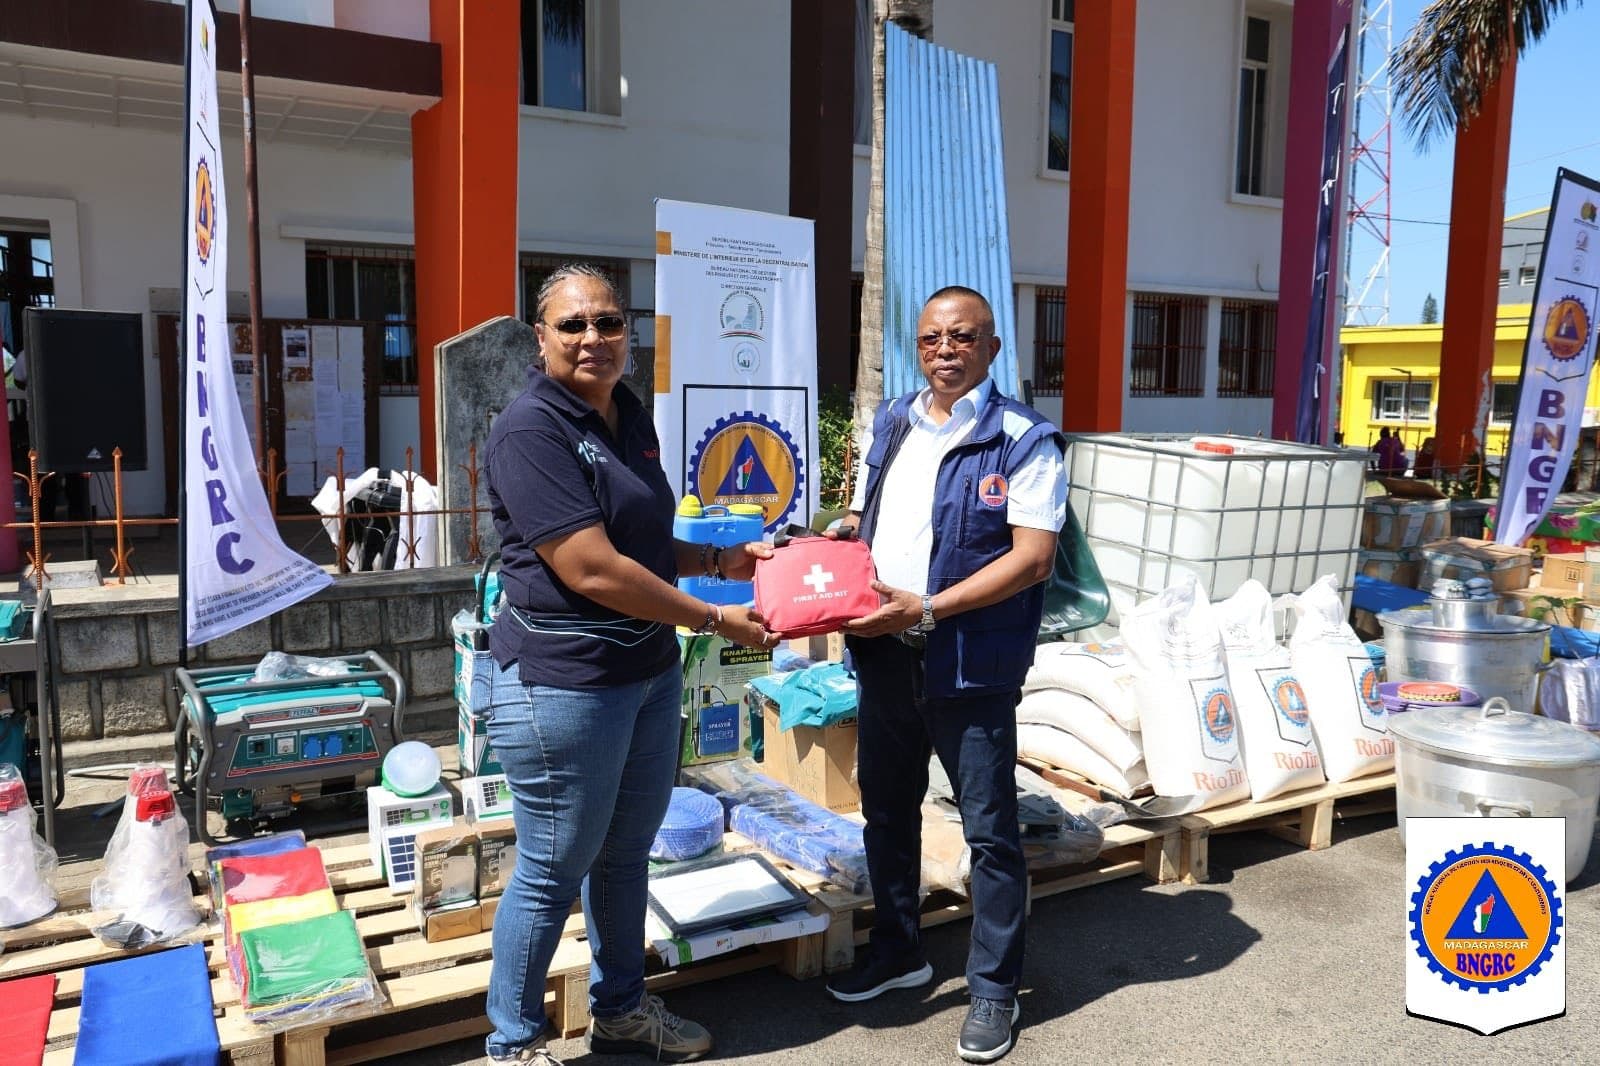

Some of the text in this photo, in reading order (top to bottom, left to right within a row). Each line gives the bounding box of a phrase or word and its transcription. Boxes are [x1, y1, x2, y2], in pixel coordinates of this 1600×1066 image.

[1525, 388, 1566, 534] BNGR
[713, 495, 779, 505] MADAGASCAR
[792, 590, 848, 603] FIRST AID KIT
[729, 655, 769, 664] SPRAYER
